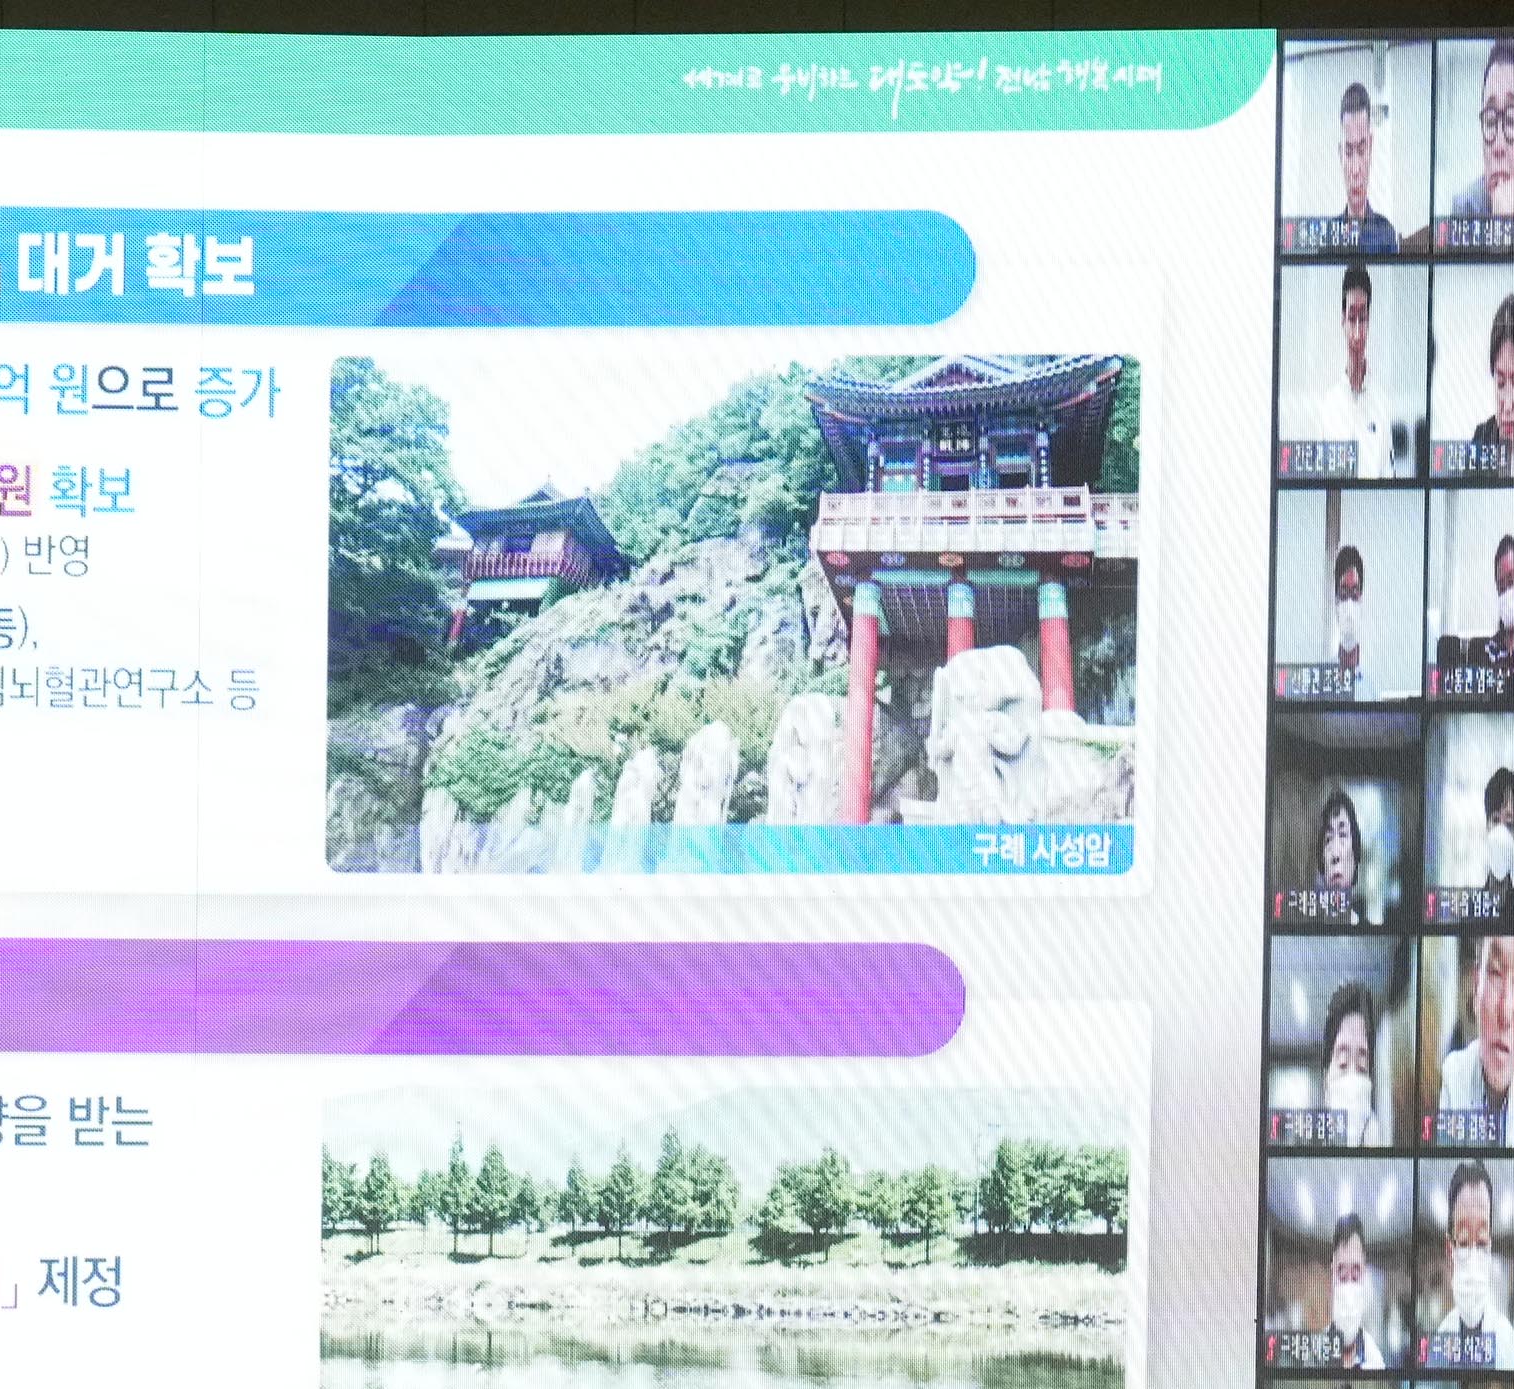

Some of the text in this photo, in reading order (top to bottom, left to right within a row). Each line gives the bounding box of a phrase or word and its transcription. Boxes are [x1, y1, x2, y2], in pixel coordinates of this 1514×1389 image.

[996, 63, 1052, 94] 전남
[17, 232, 126, 296] 대거
[144, 233, 256, 299] 확보
[49, 363, 179, 416] 원으로
[194, 366, 282, 419] 증가
[50, 465, 135, 518] 확보
[25, 535, 89, 577] 반영
[229, 670, 259, 711] 등
[975, 832, 1111, 868] 구례 사성암
[69, 1096, 153, 1147] 받는
[38, 1256, 121, 1308] 제정
